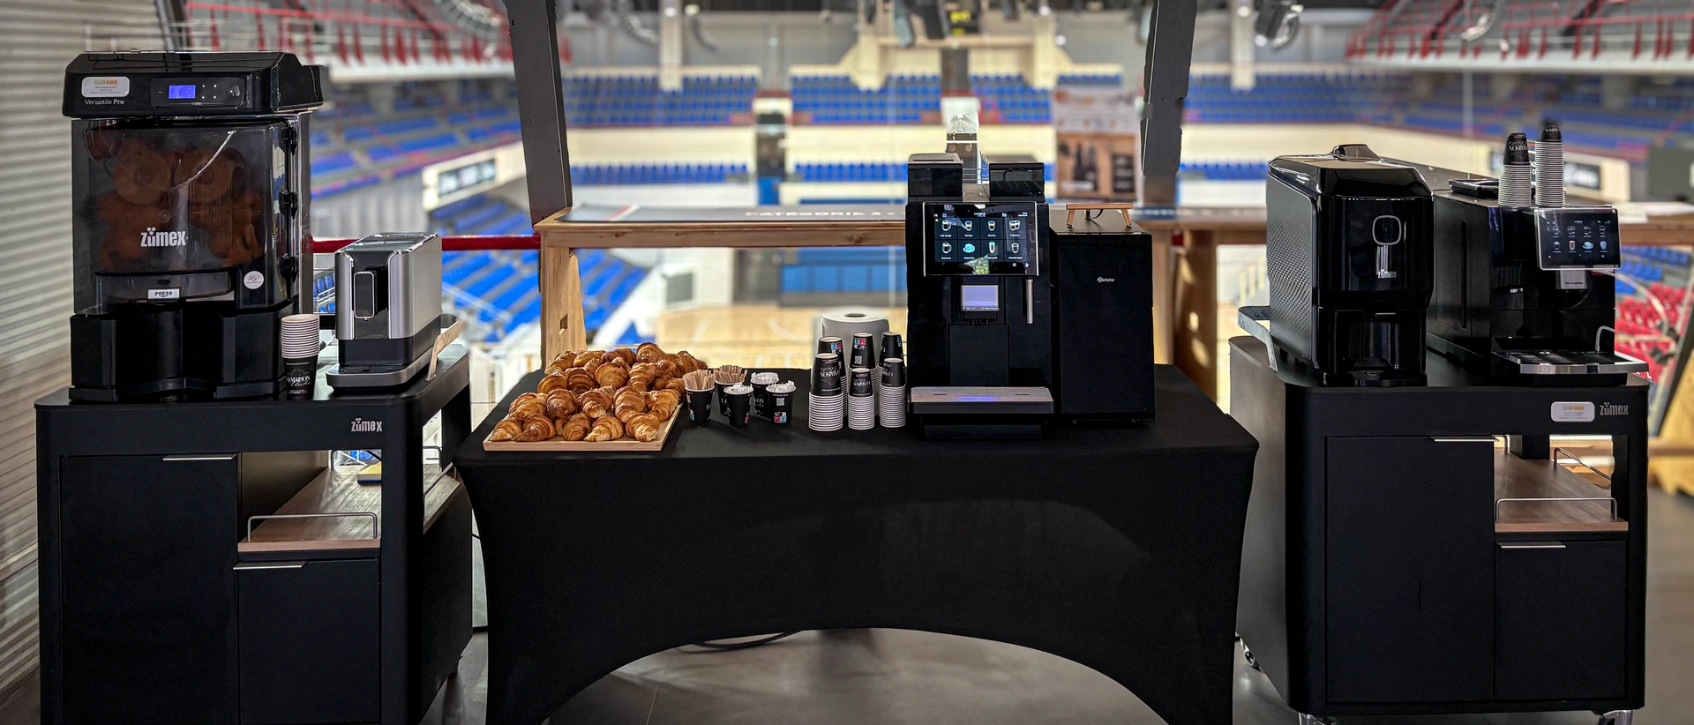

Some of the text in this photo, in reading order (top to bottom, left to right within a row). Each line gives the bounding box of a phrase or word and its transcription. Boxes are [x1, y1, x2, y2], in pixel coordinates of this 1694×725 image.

[84, 98, 112, 106] Versatile
[140, 227, 187, 248] zümex
[1600, 402, 1628, 416] zümex
[351, 417, 383, 432] zümex
